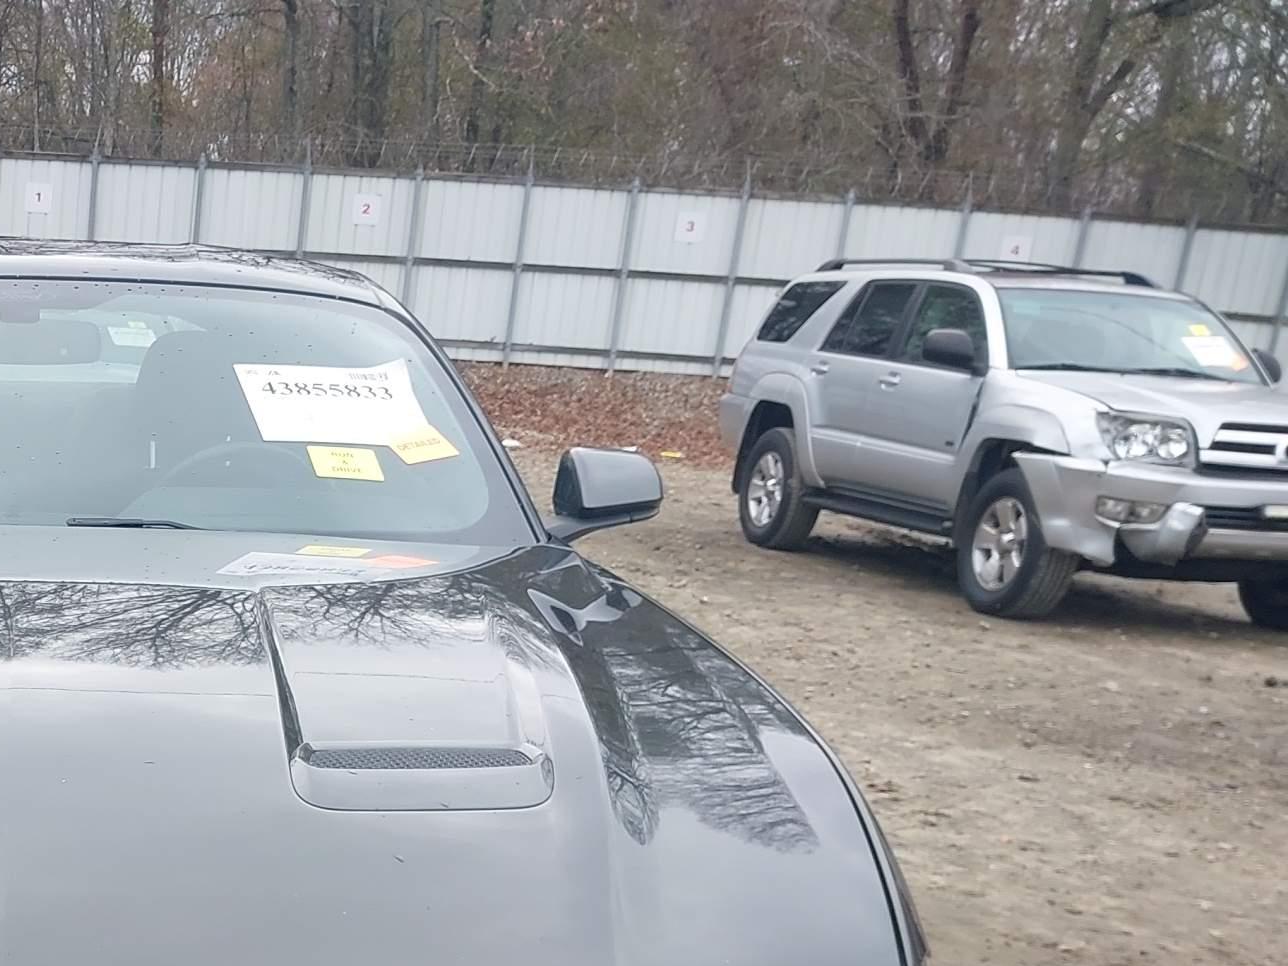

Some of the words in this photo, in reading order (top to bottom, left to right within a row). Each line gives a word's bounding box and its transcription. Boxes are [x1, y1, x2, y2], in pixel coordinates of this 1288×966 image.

[35, 192, 42, 203] 1
[361, 203, 372, 215] 2
[685, 220, 696, 232] 3
[1010, 245, 1020, 255] 4
[262, 381, 393, 400] 43855833
